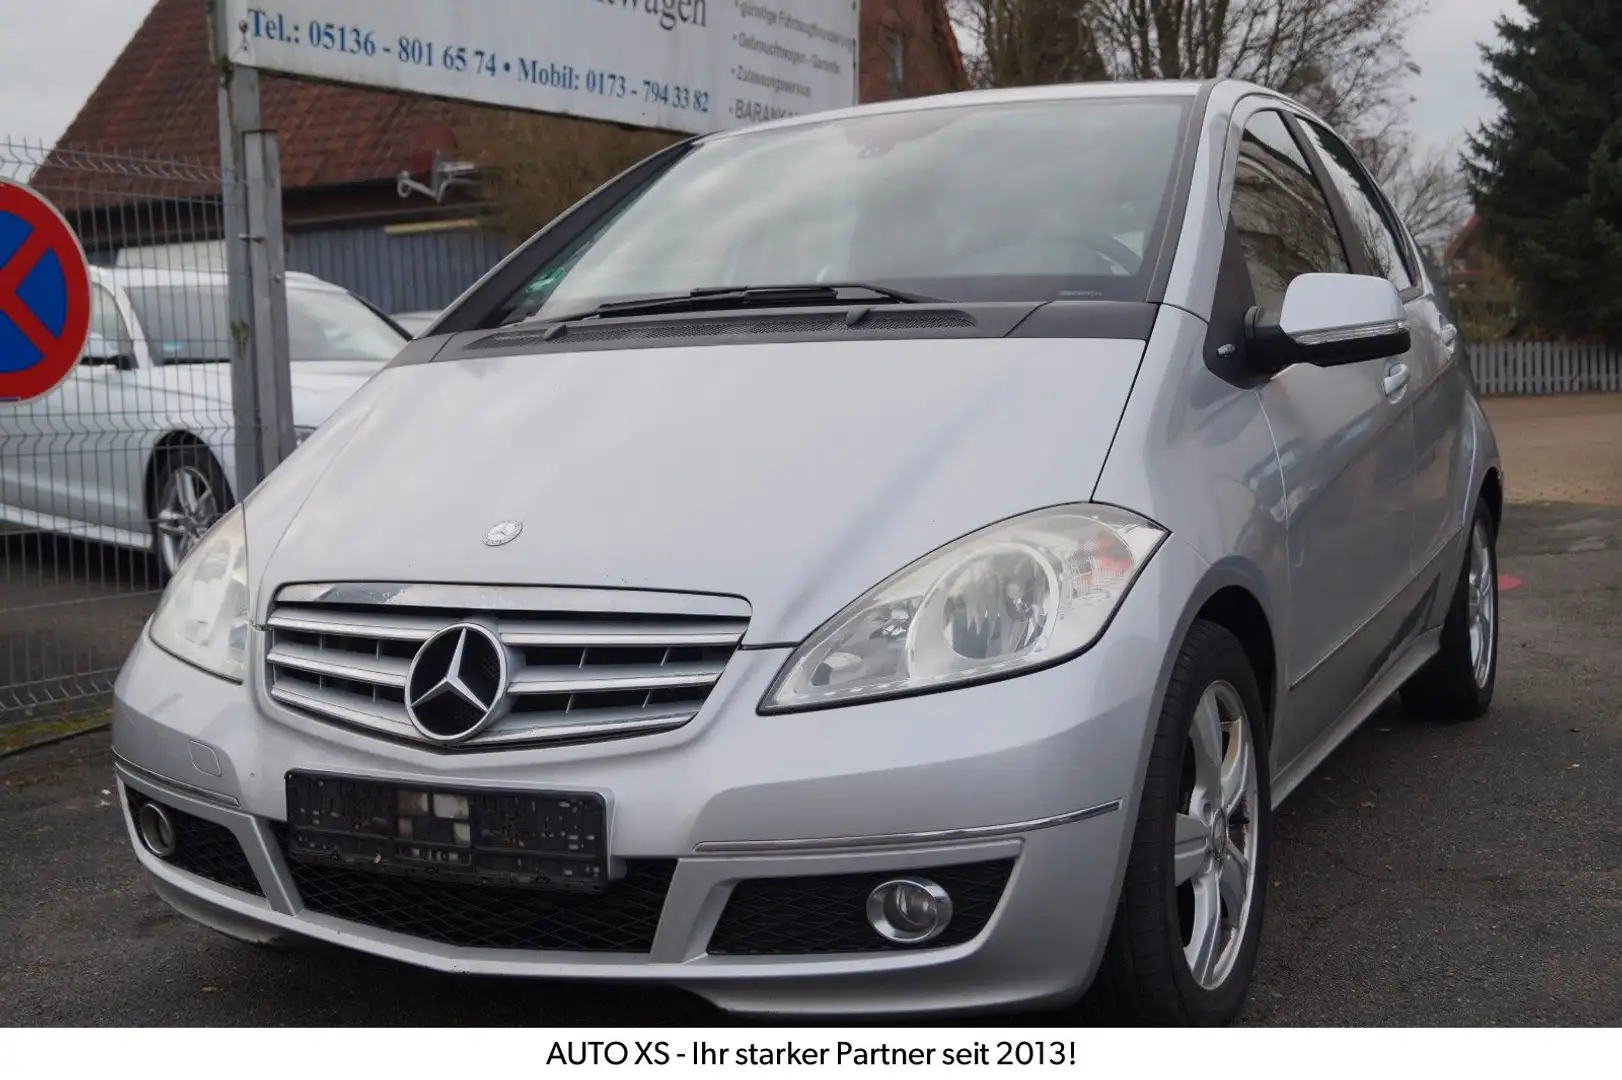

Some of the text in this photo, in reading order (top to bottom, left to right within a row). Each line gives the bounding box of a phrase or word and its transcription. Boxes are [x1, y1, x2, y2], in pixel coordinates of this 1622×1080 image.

[247, 8, 299, 44] Tel.:
[308, 20, 376, 57] 05136
[398, 36, 433, 67] 801
[442, 46, 467, 72] 65
[473, 50, 496, 77] 74
[518, 57, 580, 91] Mobil:
[586, 68, 627, 98] 0173
[642, 79, 668, 106] 794
[672, 86, 690, 110] 33
[693, 89, 709, 113] 82
